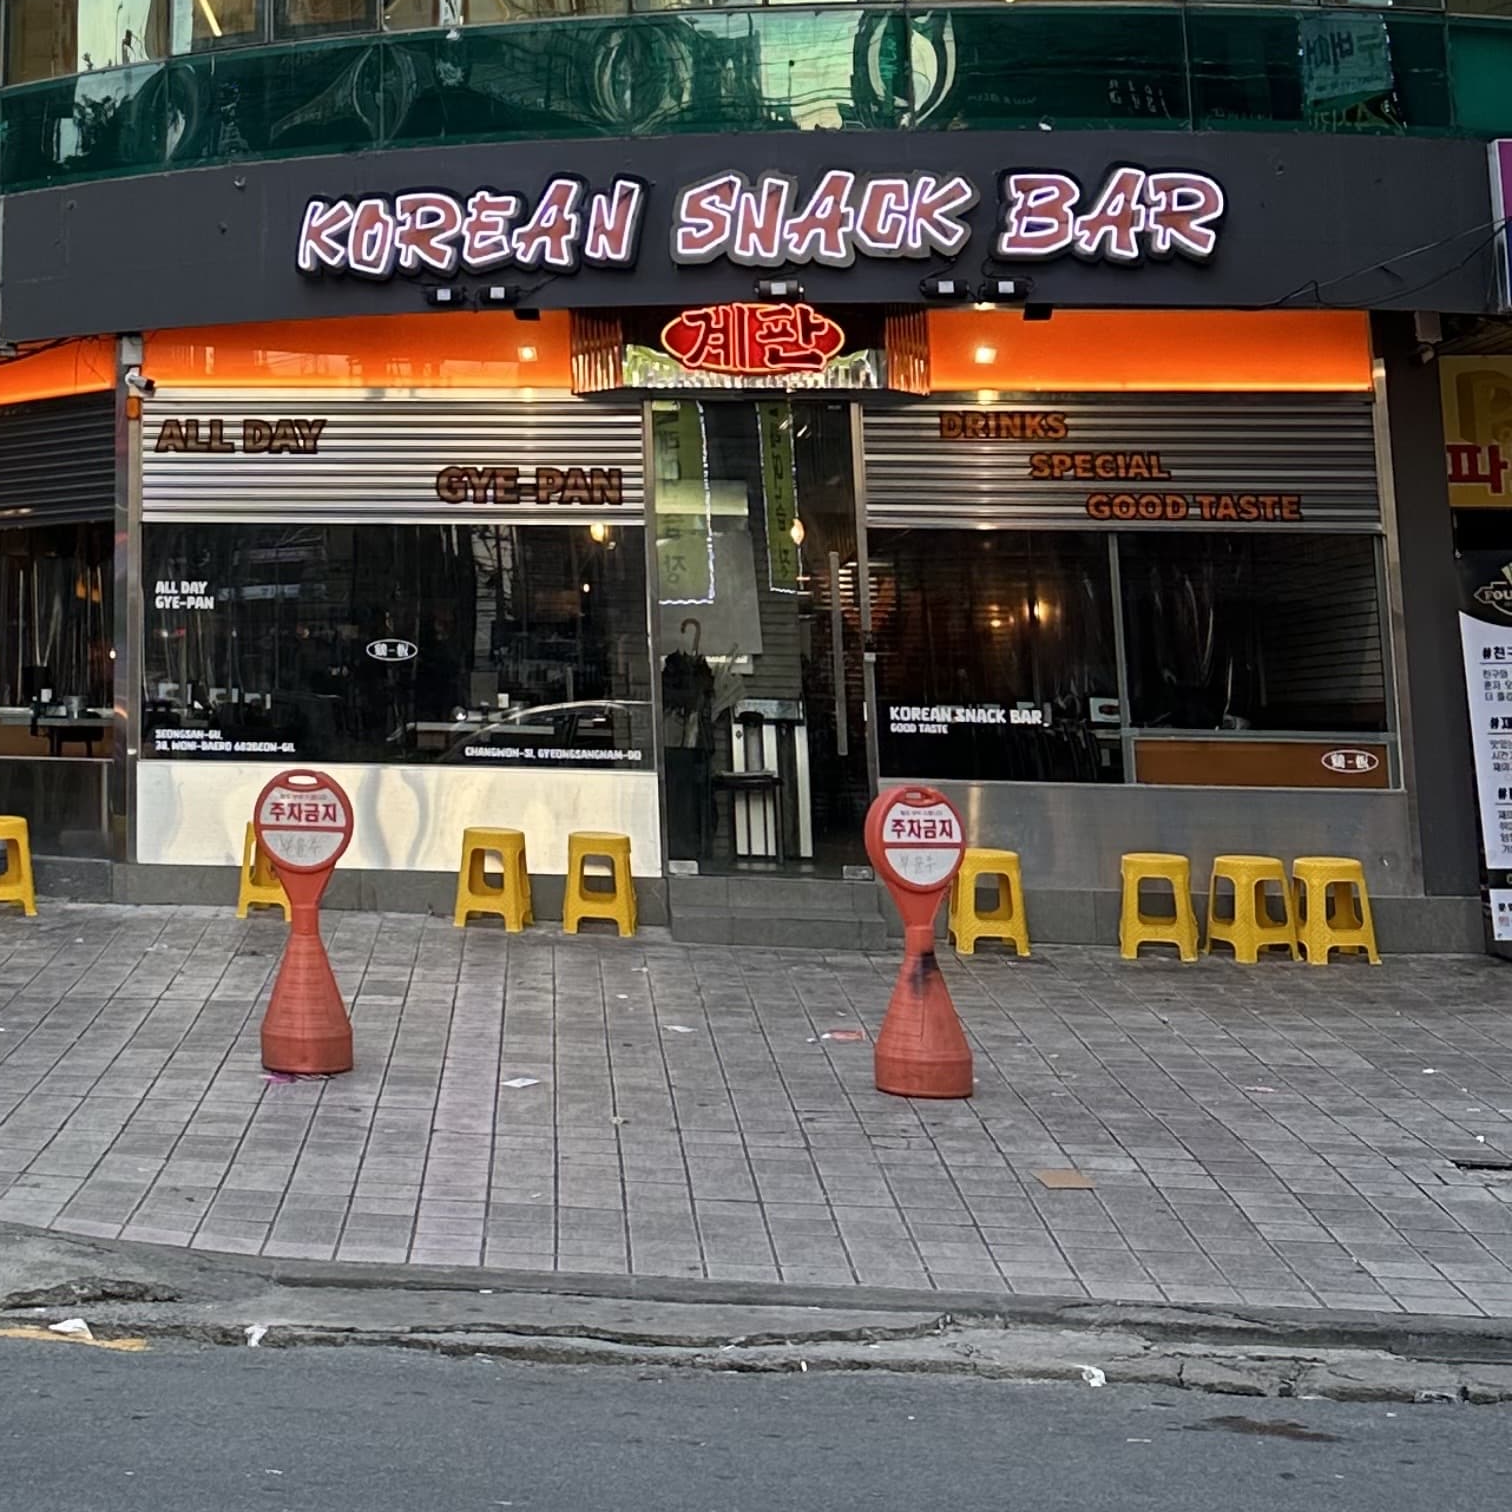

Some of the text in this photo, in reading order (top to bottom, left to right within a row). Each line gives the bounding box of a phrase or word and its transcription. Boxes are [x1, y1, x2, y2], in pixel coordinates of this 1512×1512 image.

[296, 168, 1227, 275] KOREAN SNACK BAR
[682, 303, 845, 374] 계판
[154, 418, 328, 455] ALL DAY
[939, 410, 1069, 443] DRINKS
[1030, 451, 1172, 481] SPECIAL
[435, 465, 624, 506] GYE-PAN
[1086, 493, 1302, 523] GOOD TASTE
[155, 580, 208, 594] ALL DAY
[155, 595, 215, 610] GYE-PAN
[889, 705, 952, 723] KOREAN
[952, 707, 1007, 724] SNACK
[890, 723, 949, 734] GOOD TASTE
[269, 802, 337, 823] 주차금지
[891, 819, 953, 840] 주차금지
